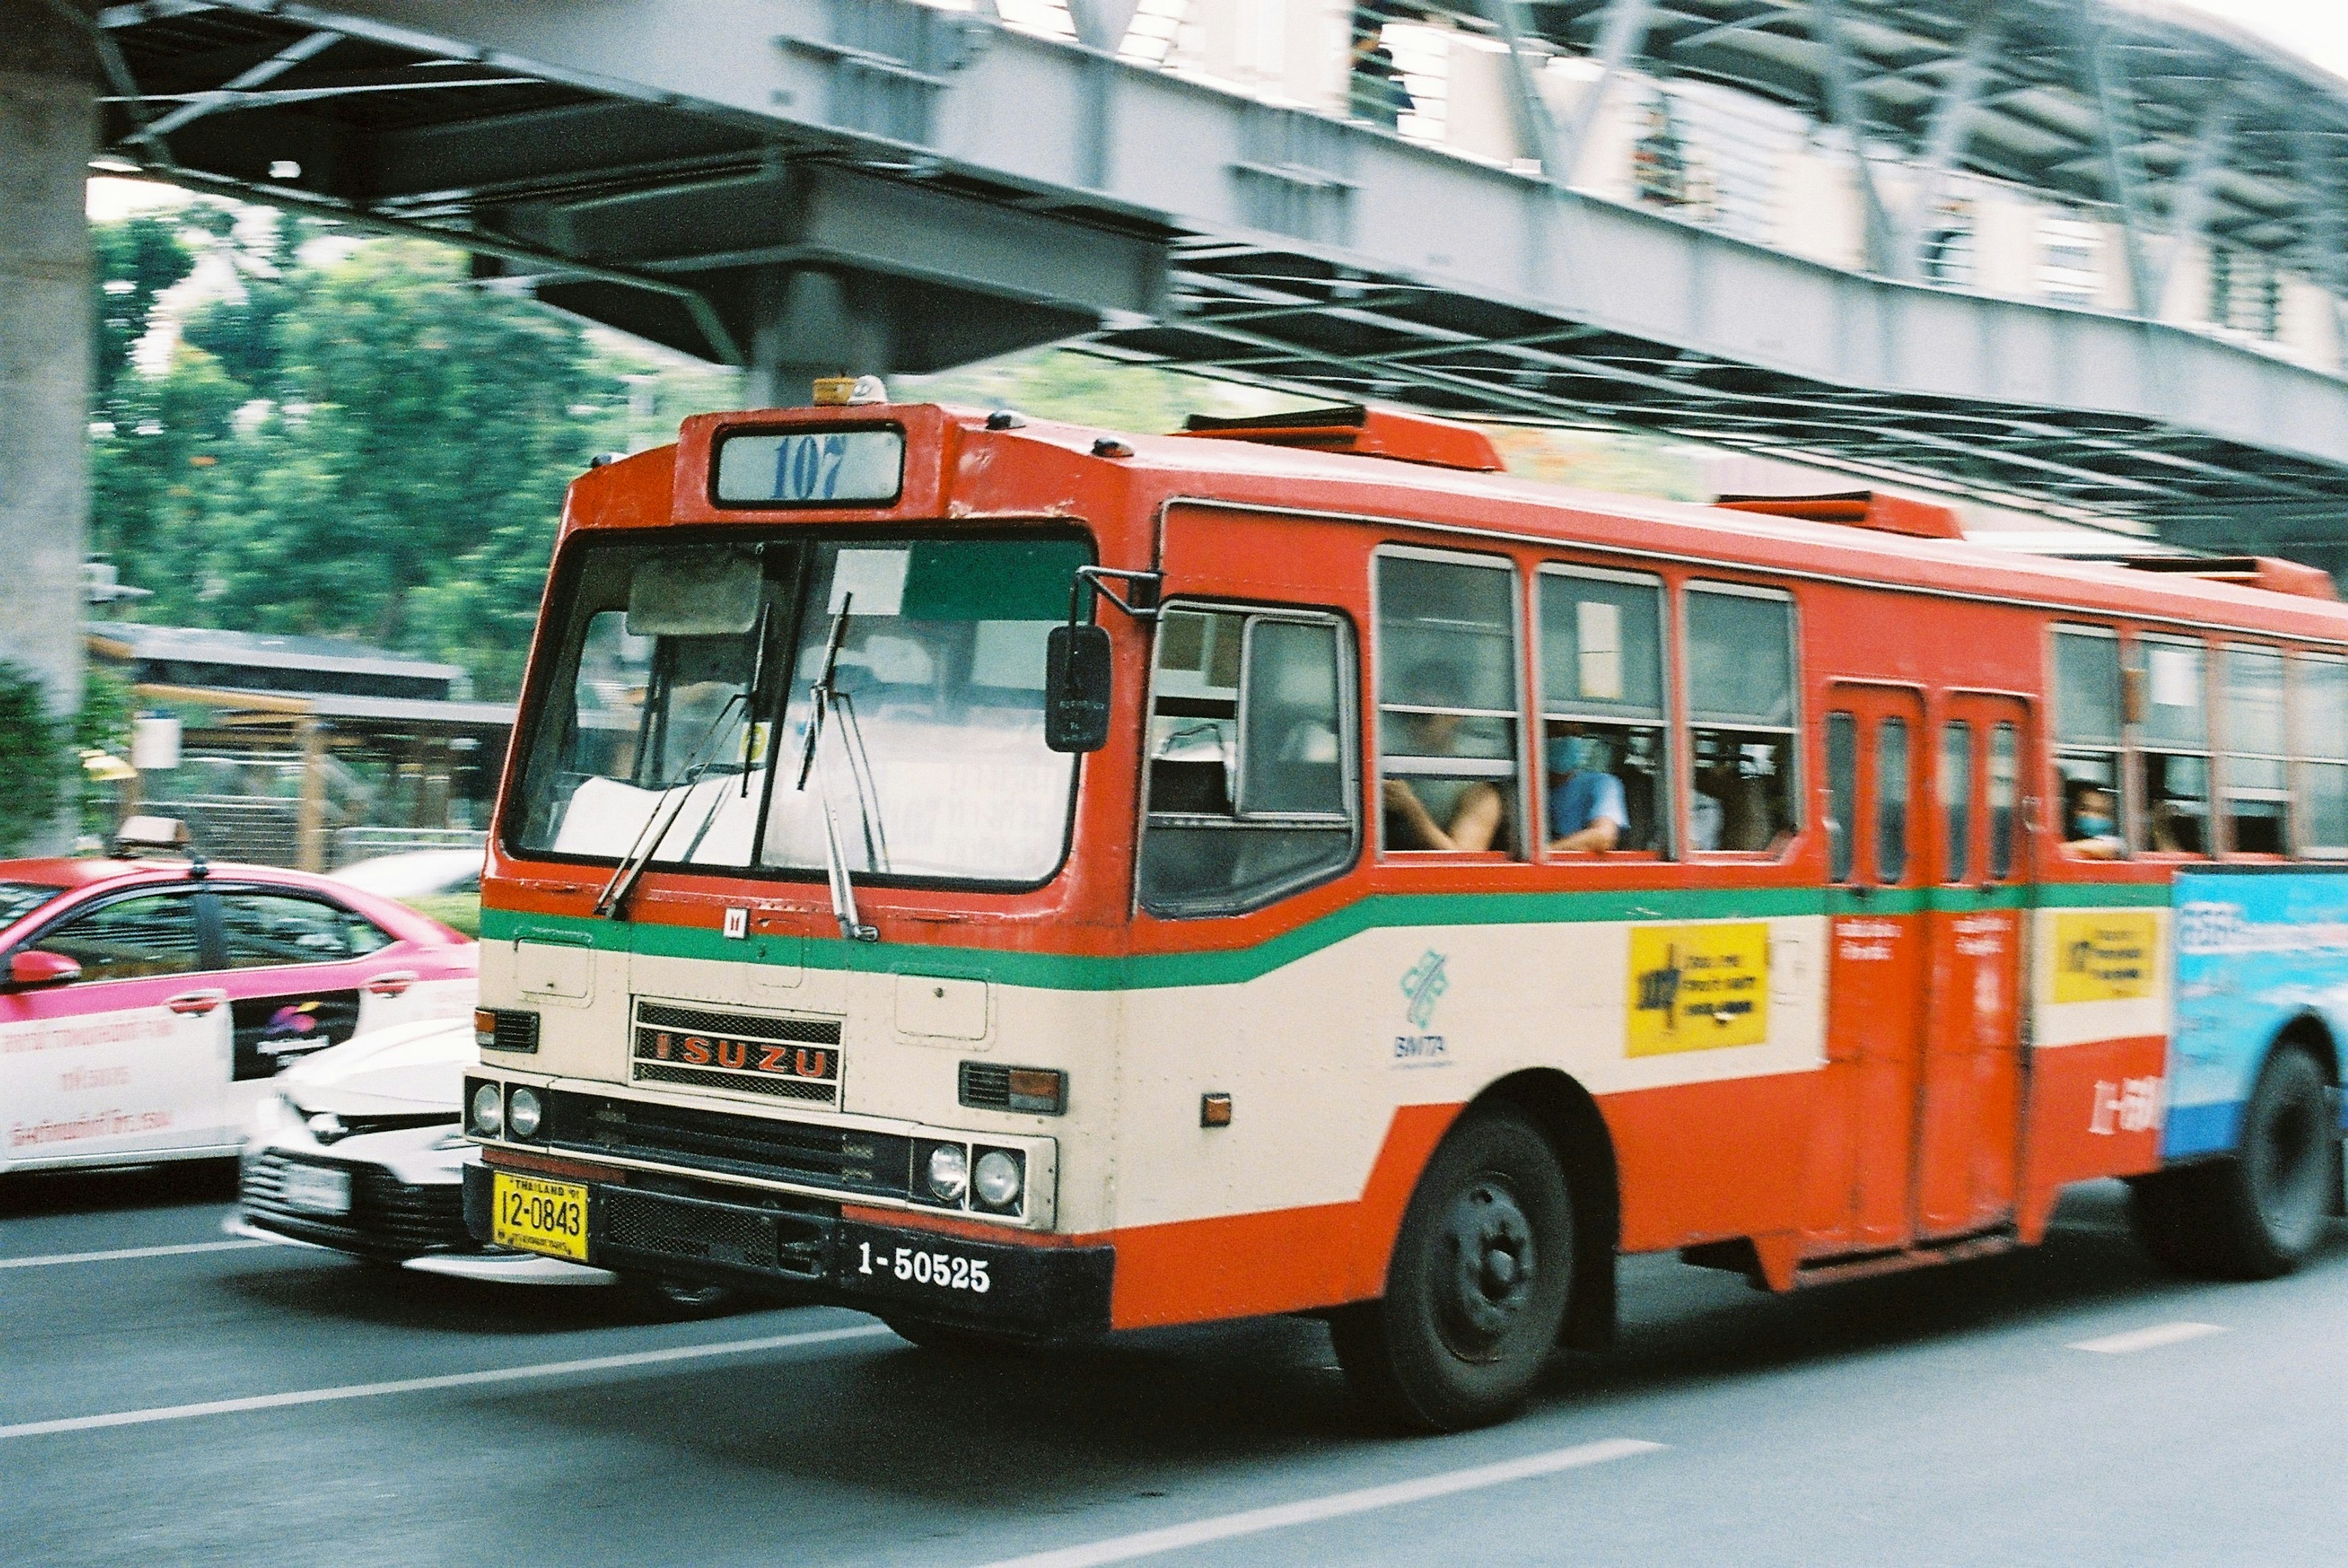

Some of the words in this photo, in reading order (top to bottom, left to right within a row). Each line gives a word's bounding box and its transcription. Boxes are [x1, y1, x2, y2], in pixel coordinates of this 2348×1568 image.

[769, 435, 847, 499] 107
[656, 1032, 825, 1078] ISUZU
[515, 1179, 564, 1196] THAILAND
[503, 1190, 580, 1236] 12-0843
[858, 1242, 991, 1294] 1-50525
